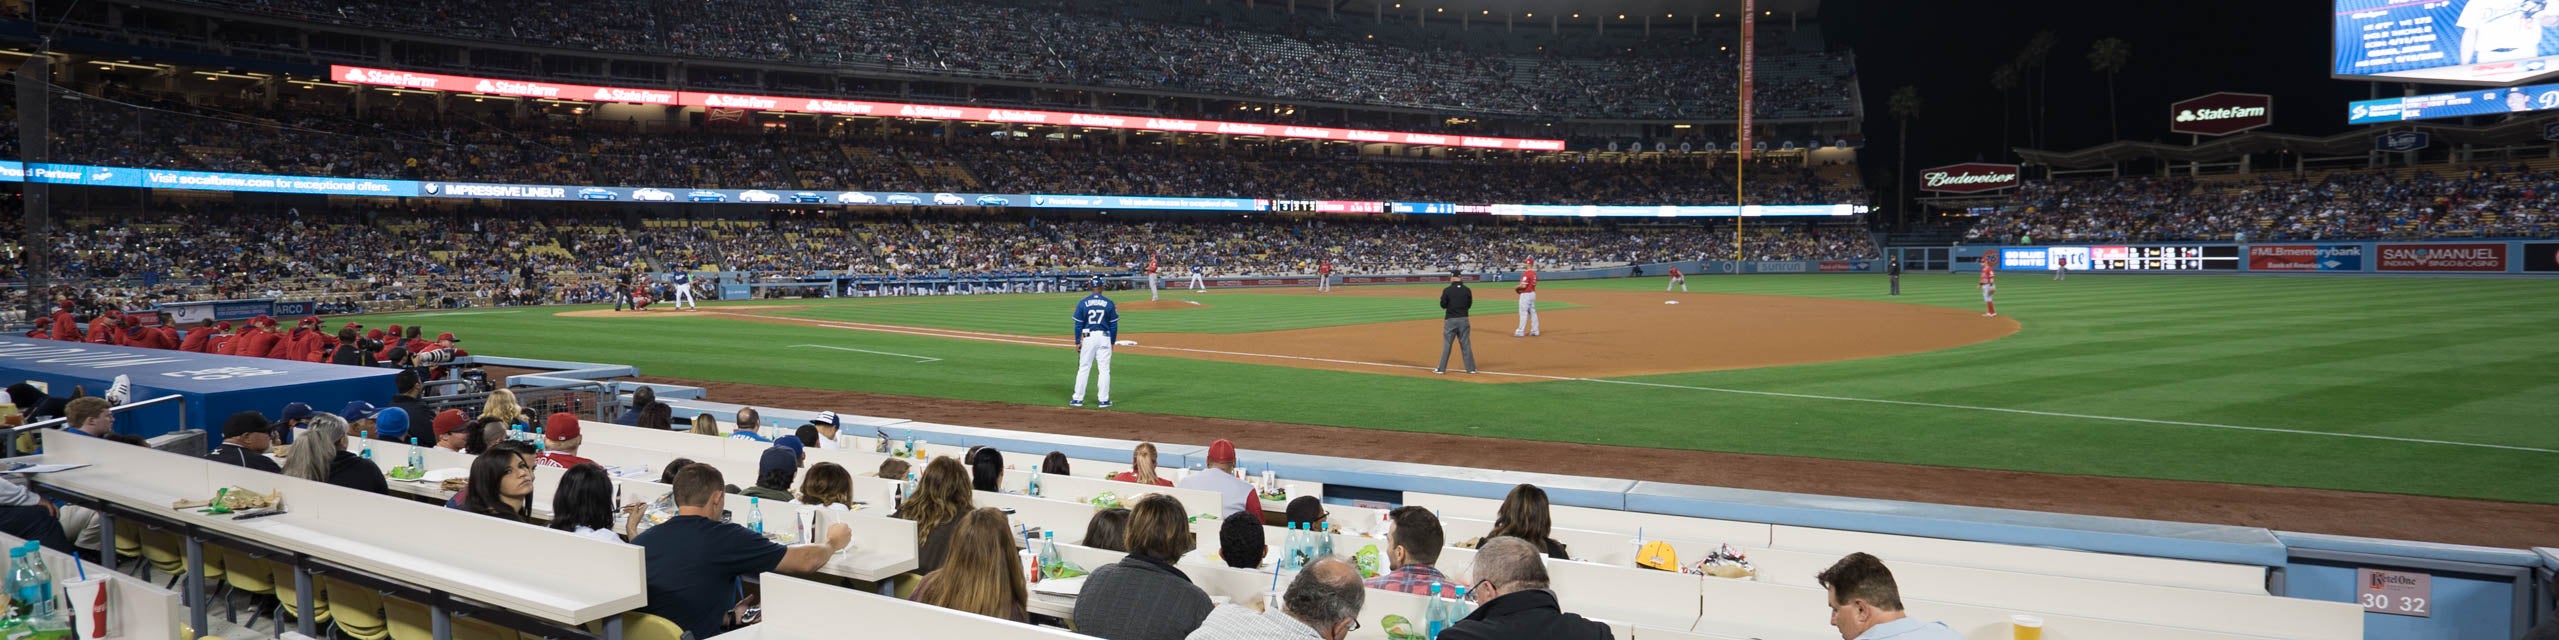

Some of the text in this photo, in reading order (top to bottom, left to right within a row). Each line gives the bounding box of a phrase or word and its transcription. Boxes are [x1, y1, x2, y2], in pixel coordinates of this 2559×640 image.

[367, 70, 438, 87] StateFarm
[495, 81, 560, 97] StateFarm
[612, 88, 672, 103] StateFarm
[2196, 106, 2265, 121] StateFarm
[35, 168, 82, 180] Partner
[1924, 171, 2016, 187] Budweiser
[149, 172, 390, 192] Visit socalbmw.com for exceptional offers.
[445, 184, 520, 197] IMPRESSIVE
[2251, 247, 2361, 258] #MLBmemorybank
[2383, 249, 2497, 260] SAN MANUEL
[276, 304, 303, 315] ARCO
[1088, 310, 1105, 324] 27
[2370, 573, 2416, 586] Ketel One
[2362, 593, 2425, 612] 30 32
